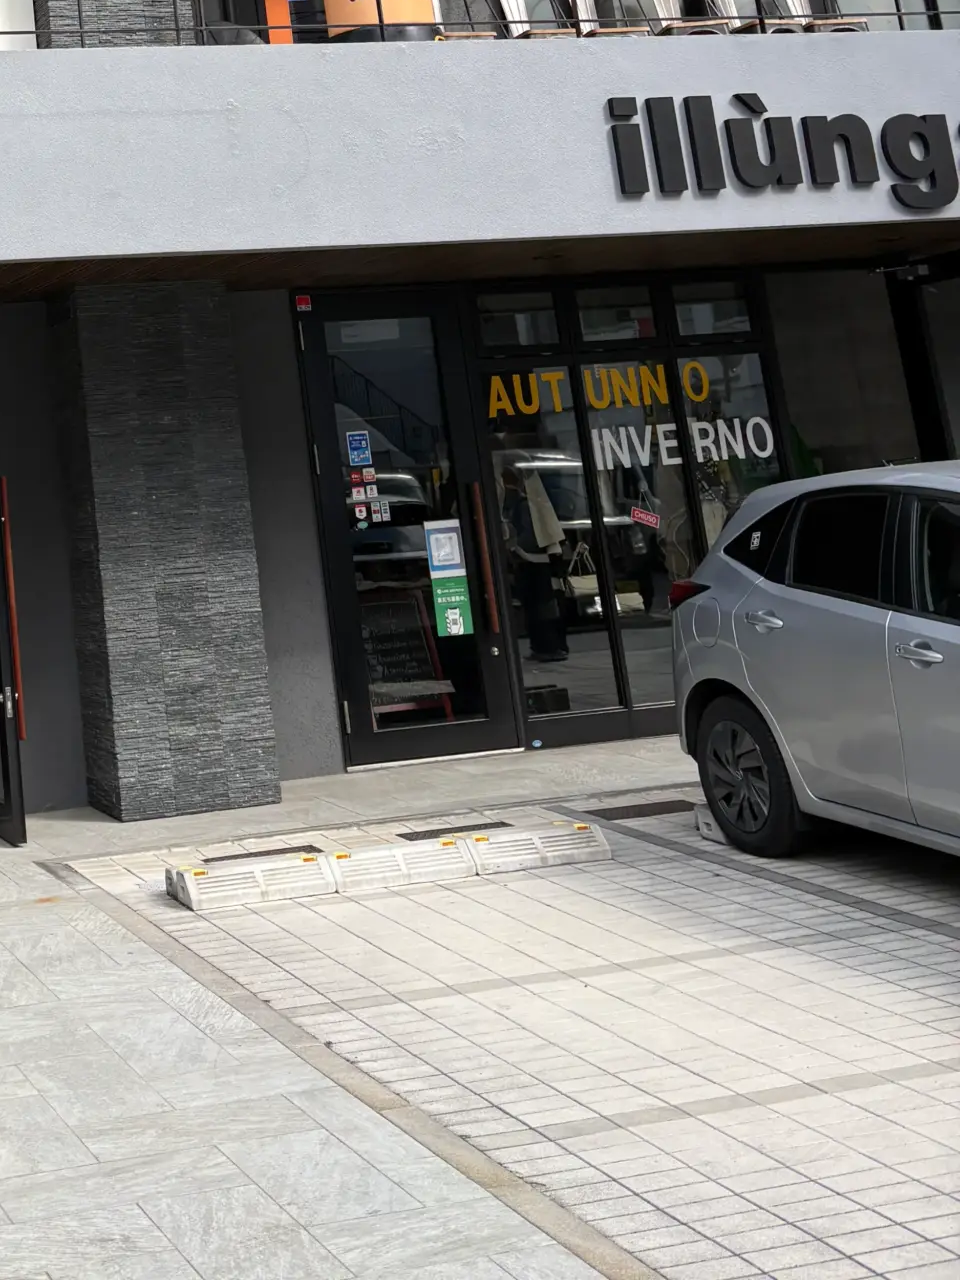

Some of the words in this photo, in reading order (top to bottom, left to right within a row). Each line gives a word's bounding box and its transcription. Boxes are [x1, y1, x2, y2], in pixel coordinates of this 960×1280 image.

[607, 92, 960, 210] illùng
[591, 416, 774, 471] INVERNO
[635, 510, 657, 524] CHIUSO
